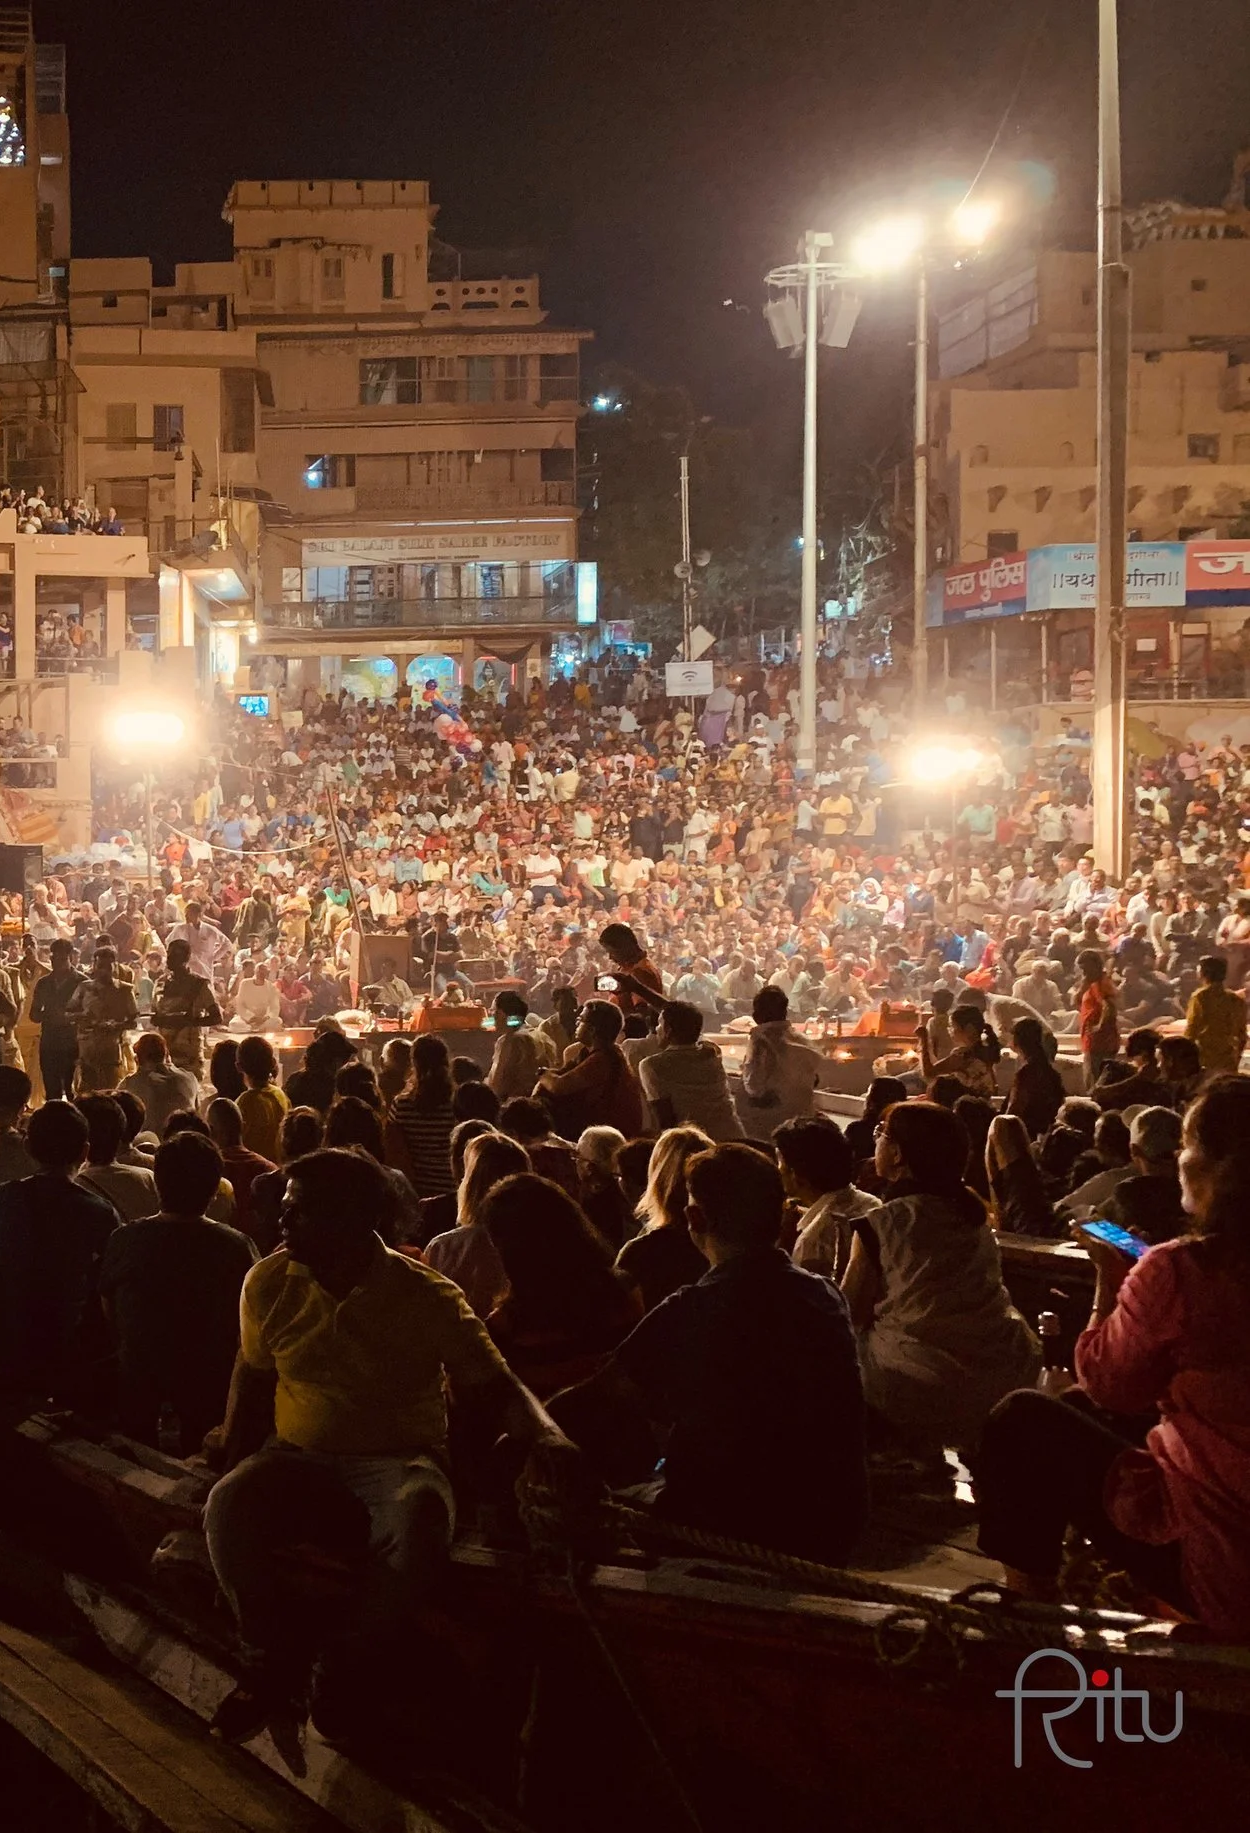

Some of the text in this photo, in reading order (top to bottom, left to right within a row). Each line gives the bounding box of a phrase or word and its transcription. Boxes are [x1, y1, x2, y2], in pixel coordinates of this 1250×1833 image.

[492, 533, 561, 547] FACTORY
[945, 557, 1027, 602] जल पुलिस
